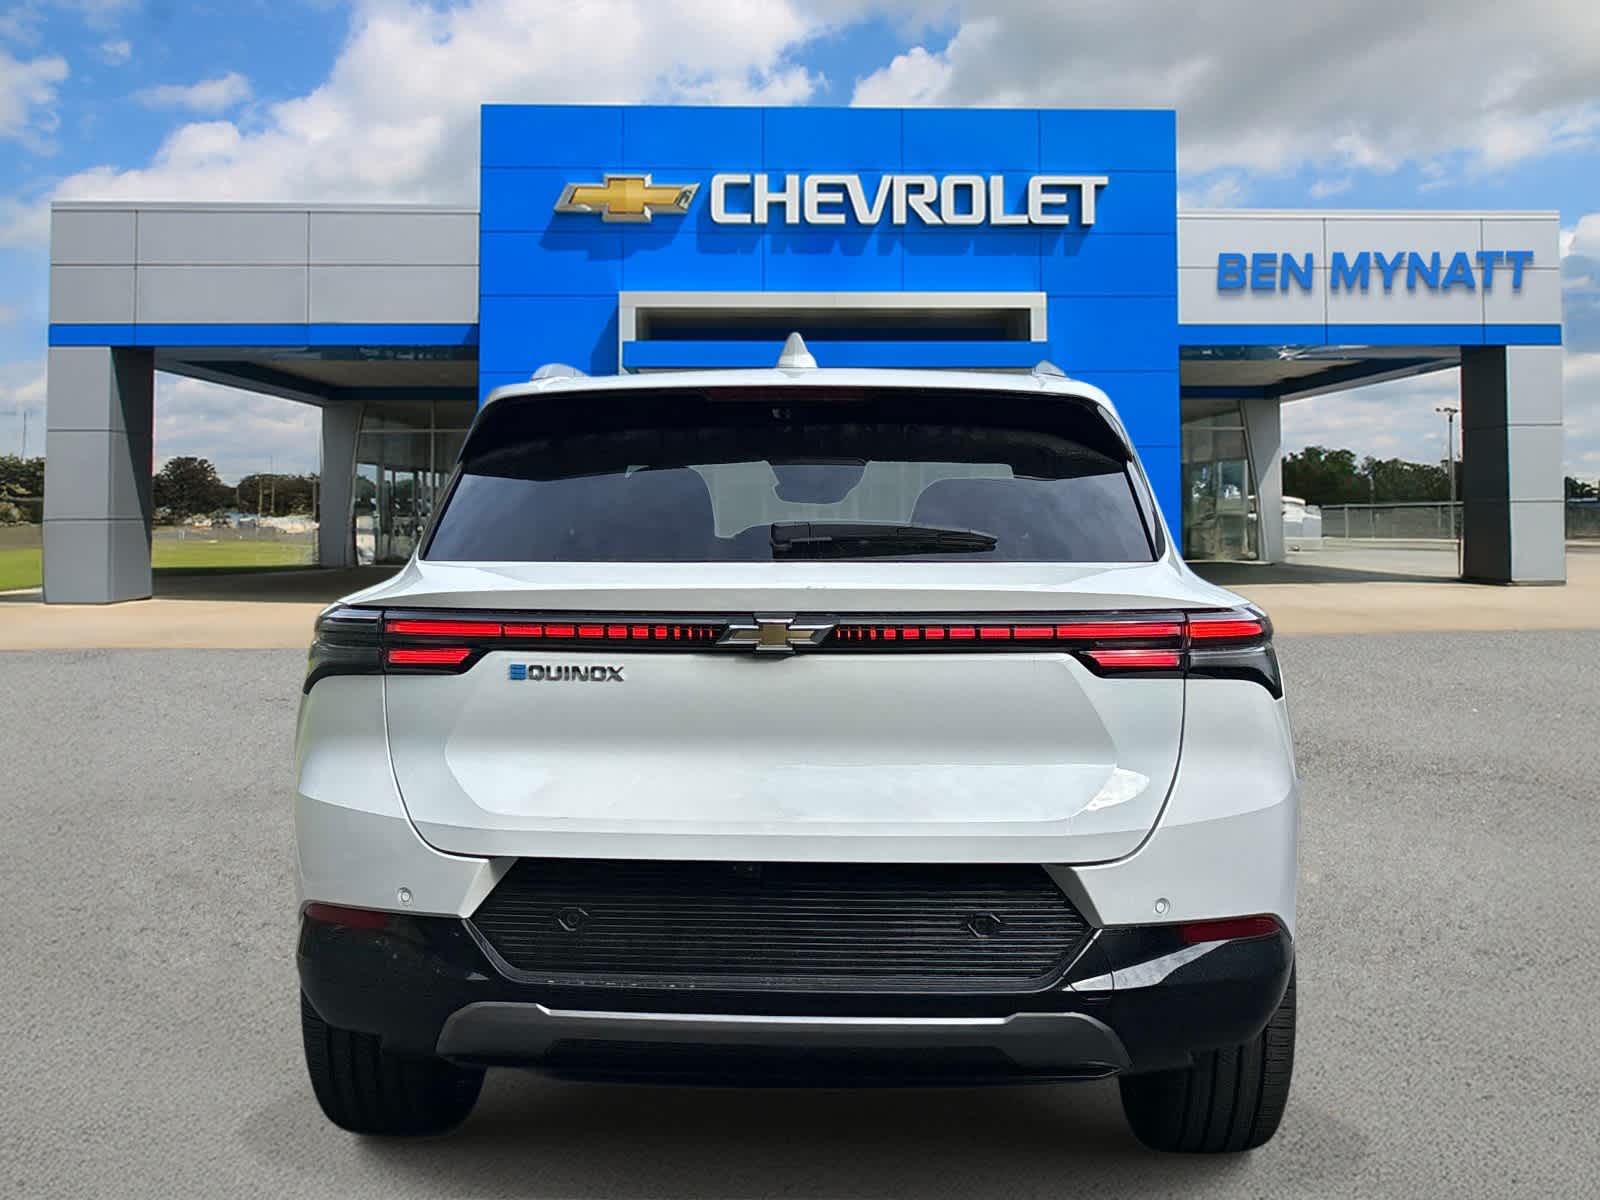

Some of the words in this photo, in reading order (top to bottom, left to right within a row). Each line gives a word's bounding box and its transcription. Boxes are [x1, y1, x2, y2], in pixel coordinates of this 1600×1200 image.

[709, 174, 1109, 225] CHEVROLET
[1217, 251, 1314, 290] BEN
[1330, 250, 1534, 290] MYNATT
[509, 664, 624, 682] EQUINOX
